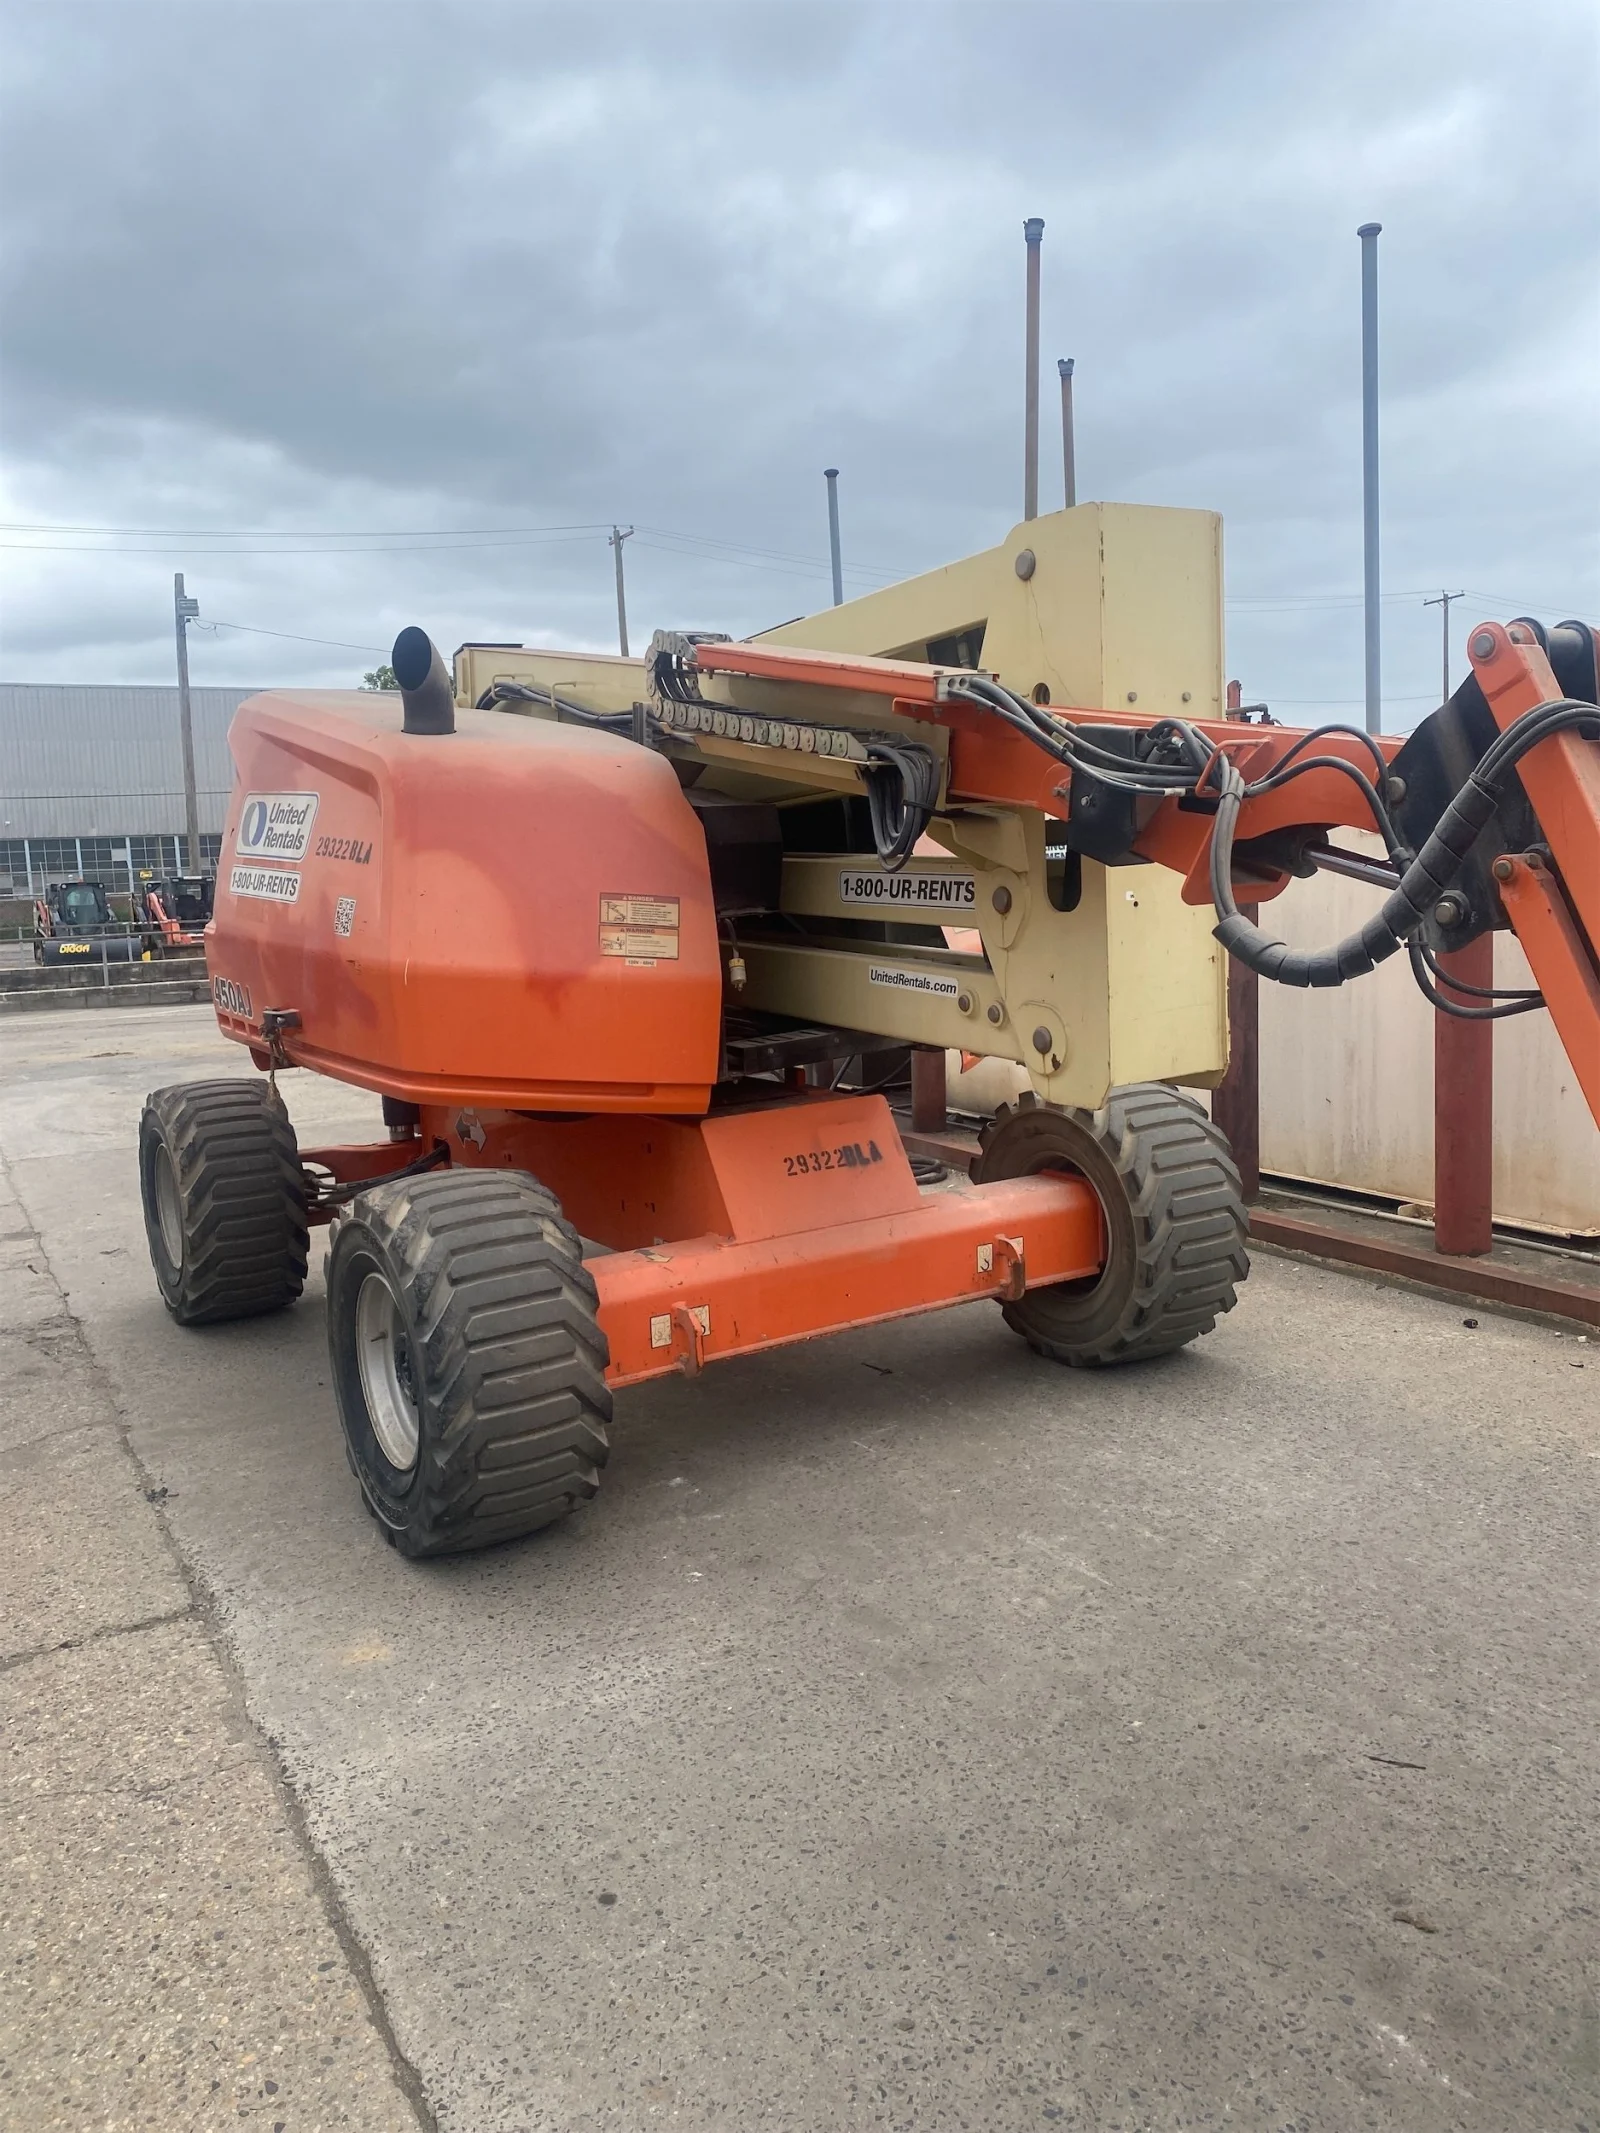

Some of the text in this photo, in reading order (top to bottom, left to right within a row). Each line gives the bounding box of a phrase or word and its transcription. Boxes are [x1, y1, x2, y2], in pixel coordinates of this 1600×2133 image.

[269, 802, 309, 825] United
[263, 827, 305, 850] Rentals
[231, 871, 298, 897] 1-800-UR-RENTS
[843, 878, 975, 902] 1-800-UR-RENTS
[870, 969, 957, 994] UnitedRentals.com
[214, 975, 253, 1019] 450AJ
